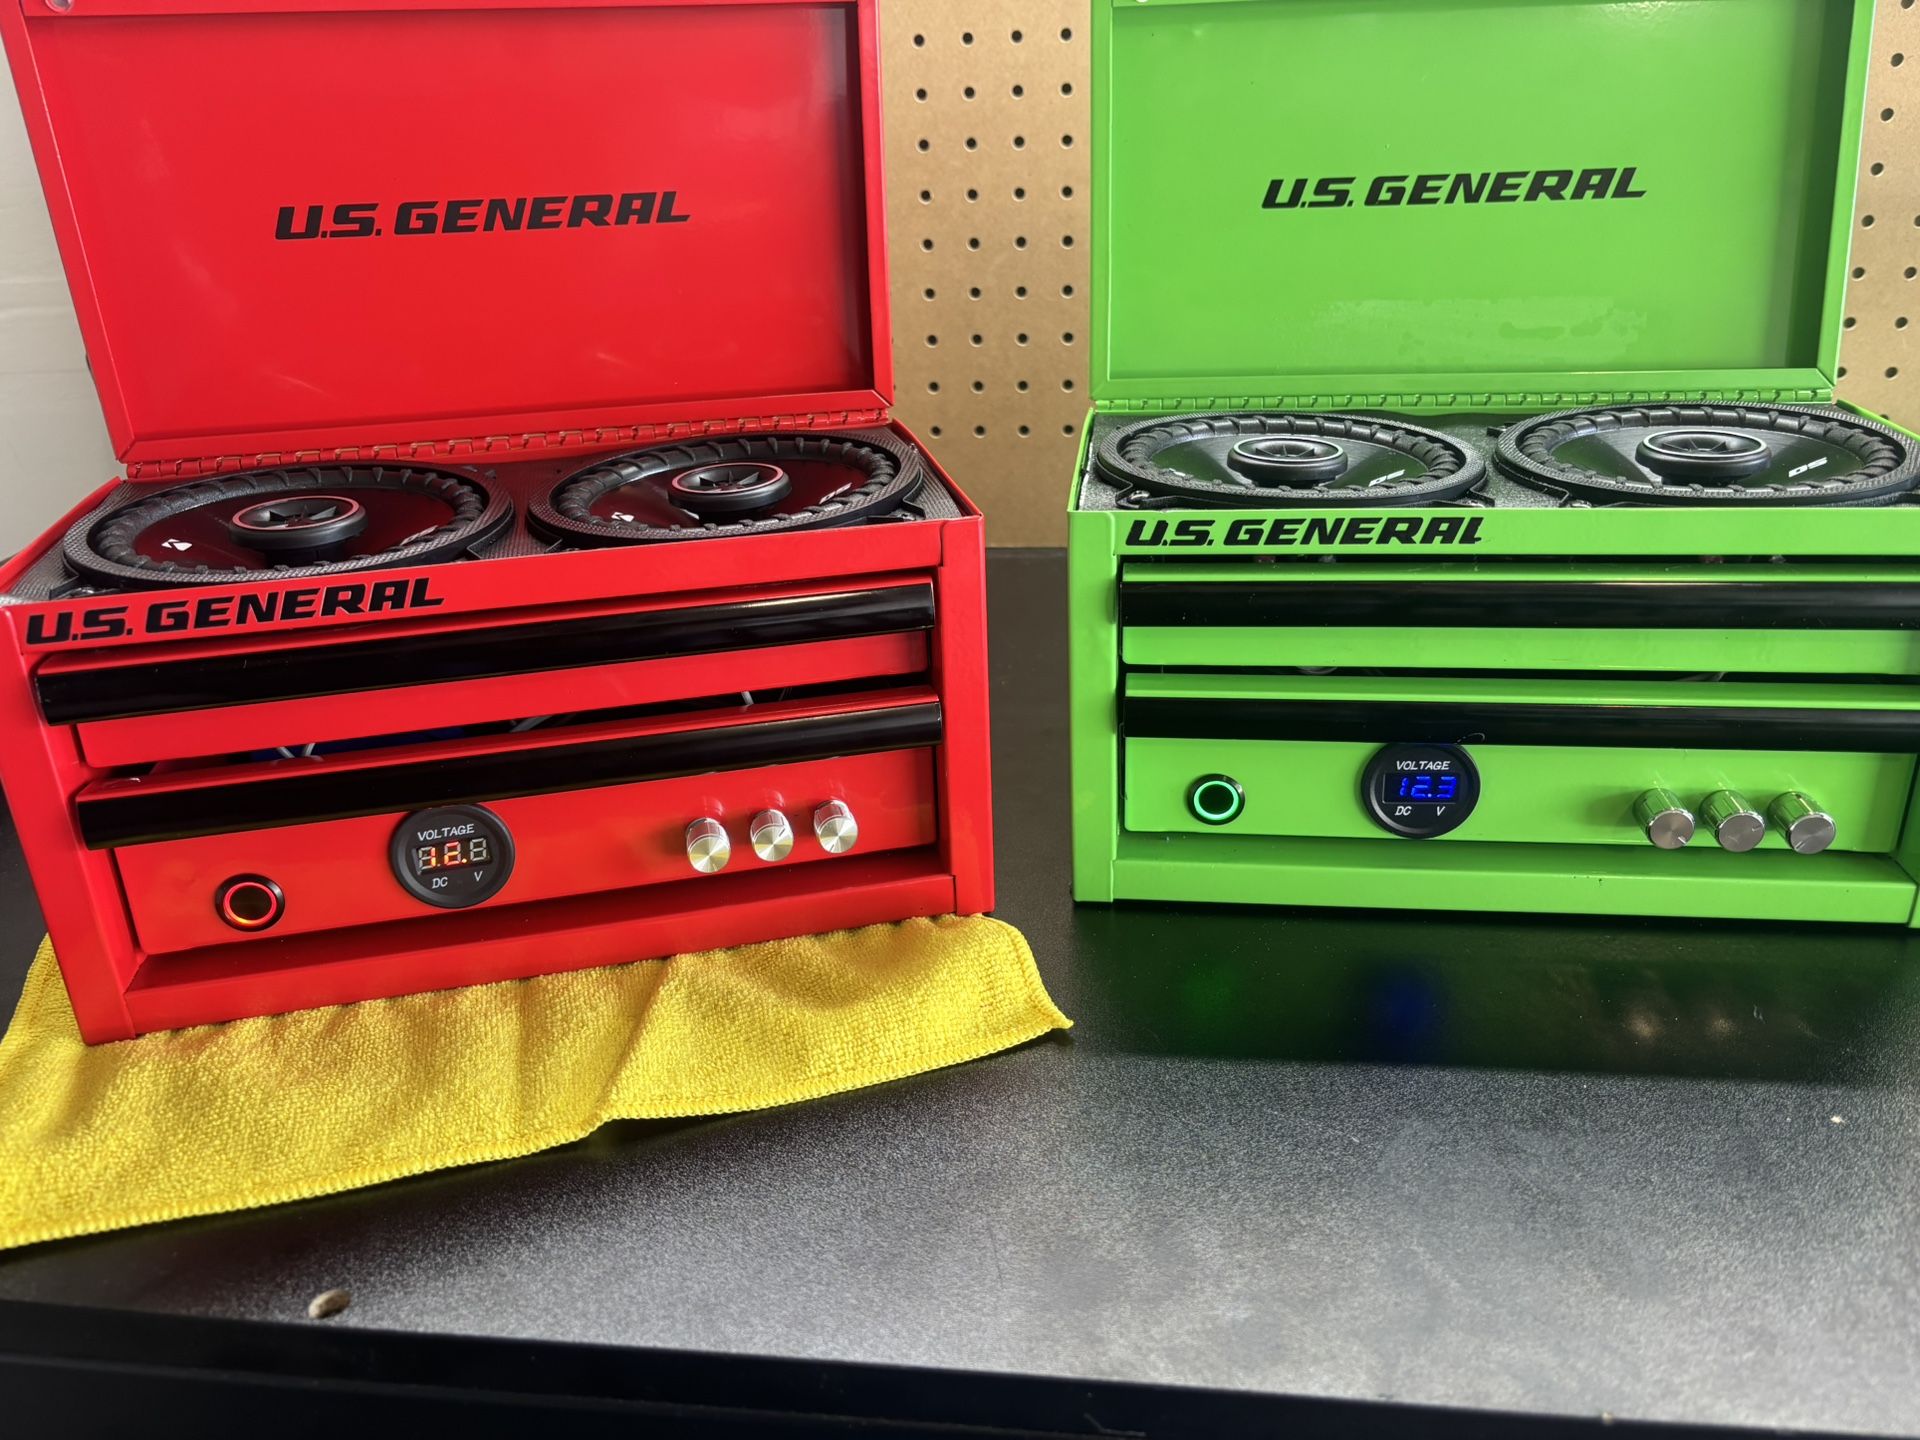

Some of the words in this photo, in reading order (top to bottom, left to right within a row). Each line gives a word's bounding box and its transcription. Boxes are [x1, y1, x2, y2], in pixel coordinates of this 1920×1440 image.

[1261, 177, 1357, 209] U.S.
[1363, 167, 1647, 206] GENERAL
[275, 203, 381, 240] U.S.
[393, 191, 691, 236] GENERAL
[1125, 519, 1217, 547] U.S.
[1222, 517, 1485, 546] GENERAL
[26, 606, 134, 646] U.S.
[145, 577, 445, 634] GENERAL
[1396, 760, 1451, 771] VOLTAGE
[1399, 776, 1457, 799] 12.3
[1394, 805, 1413, 816] DC
[1436, 805, 1446, 817] V
[417, 823, 475, 841] VOLTAGE
[431, 876, 449, 889] DC
[474, 870, 484, 882] V
